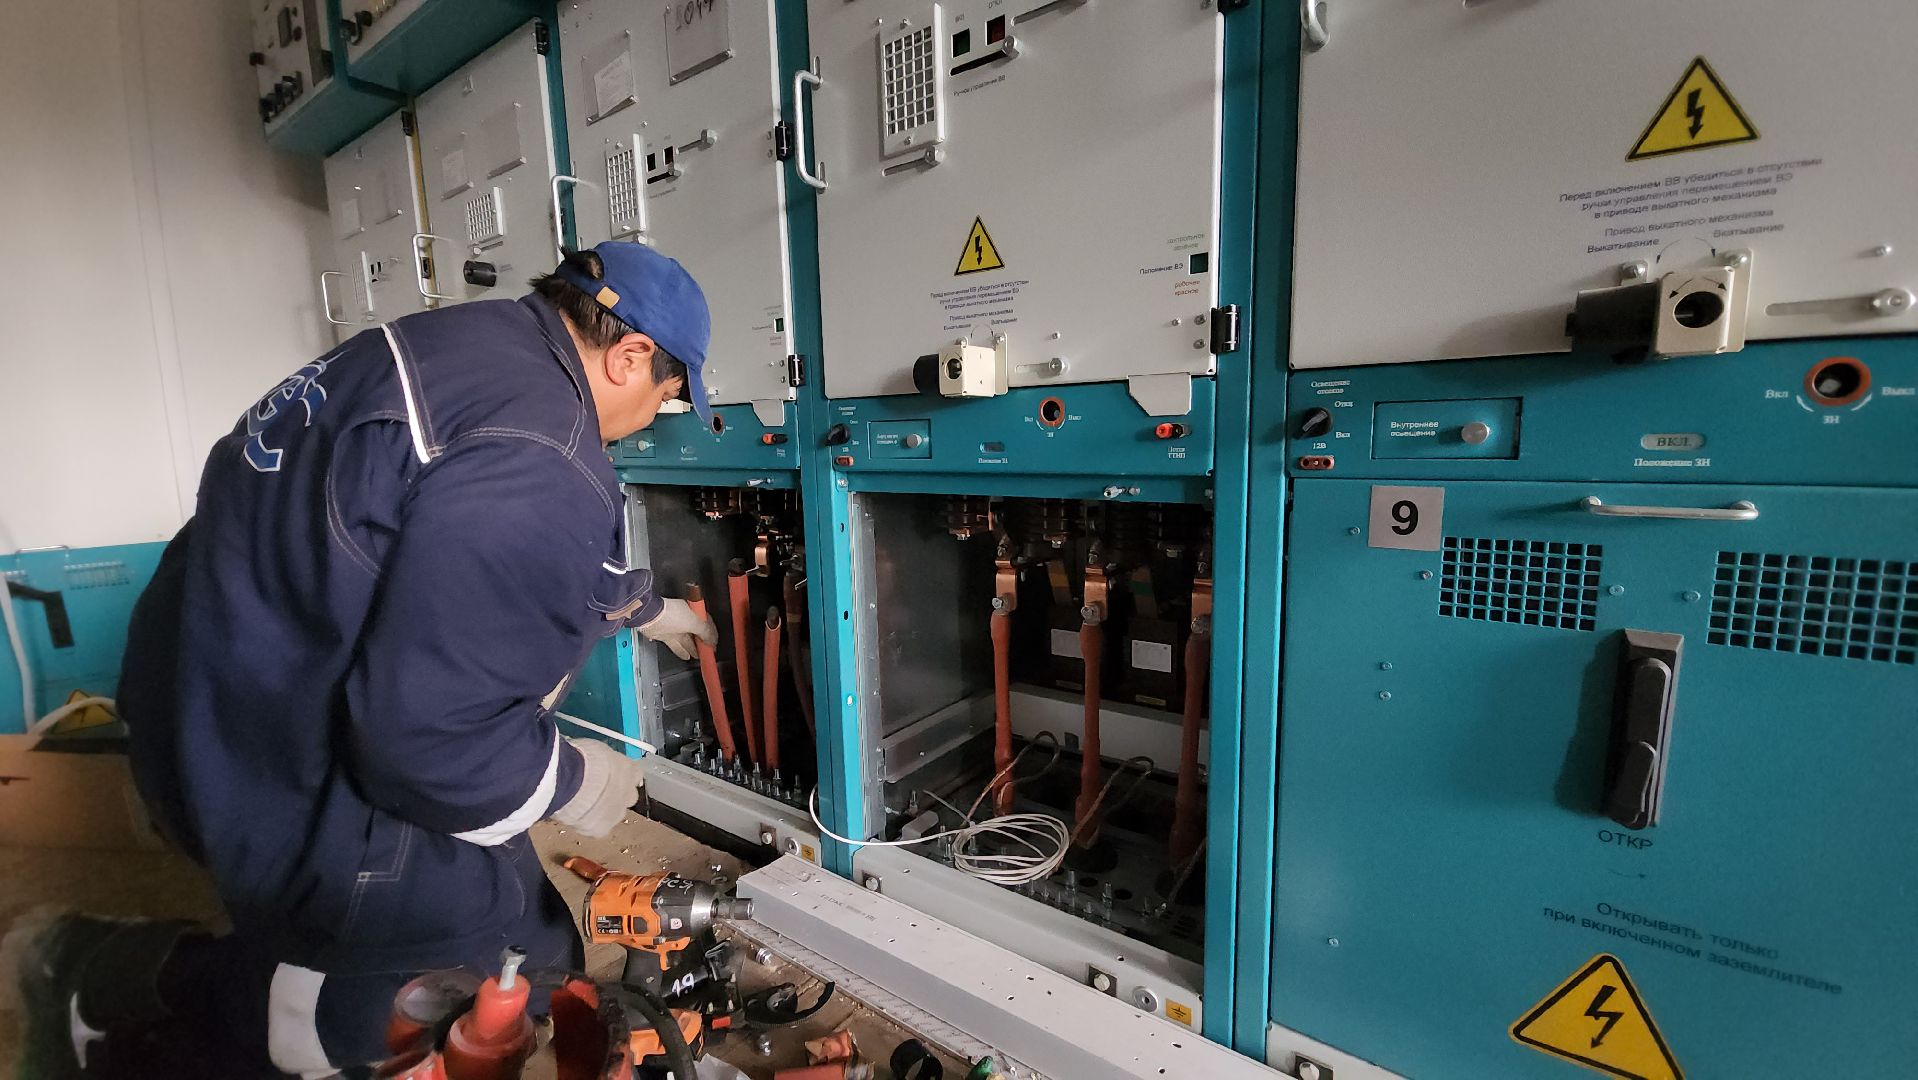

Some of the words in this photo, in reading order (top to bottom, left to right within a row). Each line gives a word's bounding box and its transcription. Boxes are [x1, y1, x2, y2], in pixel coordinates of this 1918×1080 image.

[1559, 190, 1592, 203] Перед
[1595, 180, 1661, 198] включением
[1665, 176, 1681, 187] ВВ
[1684, 168, 1744, 185] убедиться
[1614, 190, 1679, 208] управления
[1776, 172, 1793, 184] ВЭ
[1594, 211, 1601, 219] в
[1603, 203, 1649, 219] приводе
[1651, 196, 1710, 212] выкатного
[1712, 186, 1777, 203] механизма
[1604, 224, 1646, 237] Привод
[1648, 216, 1706, 232] выкатного
[1708, 208, 1774, 224] механизма
[1587, 238, 1660, 253] Выкатывание
[1765, 389, 1789, 400] Вкл
[1390, 421, 1439, 430] Внутреннее
[1390, 430, 1436, 438] освещение
[1694, 457, 1711, 467] ЗН
[1391, 499, 1420, 536] 9
[1597, 829, 1654, 851] ОТКР
[1596, 902, 1703, 941] Открывать
[1709, 933, 1780, 961] только
[1543, 906, 1577, 926] при
[1581, 917, 1701, 960] включенном
[1707, 952, 1844, 996] заземлителе
